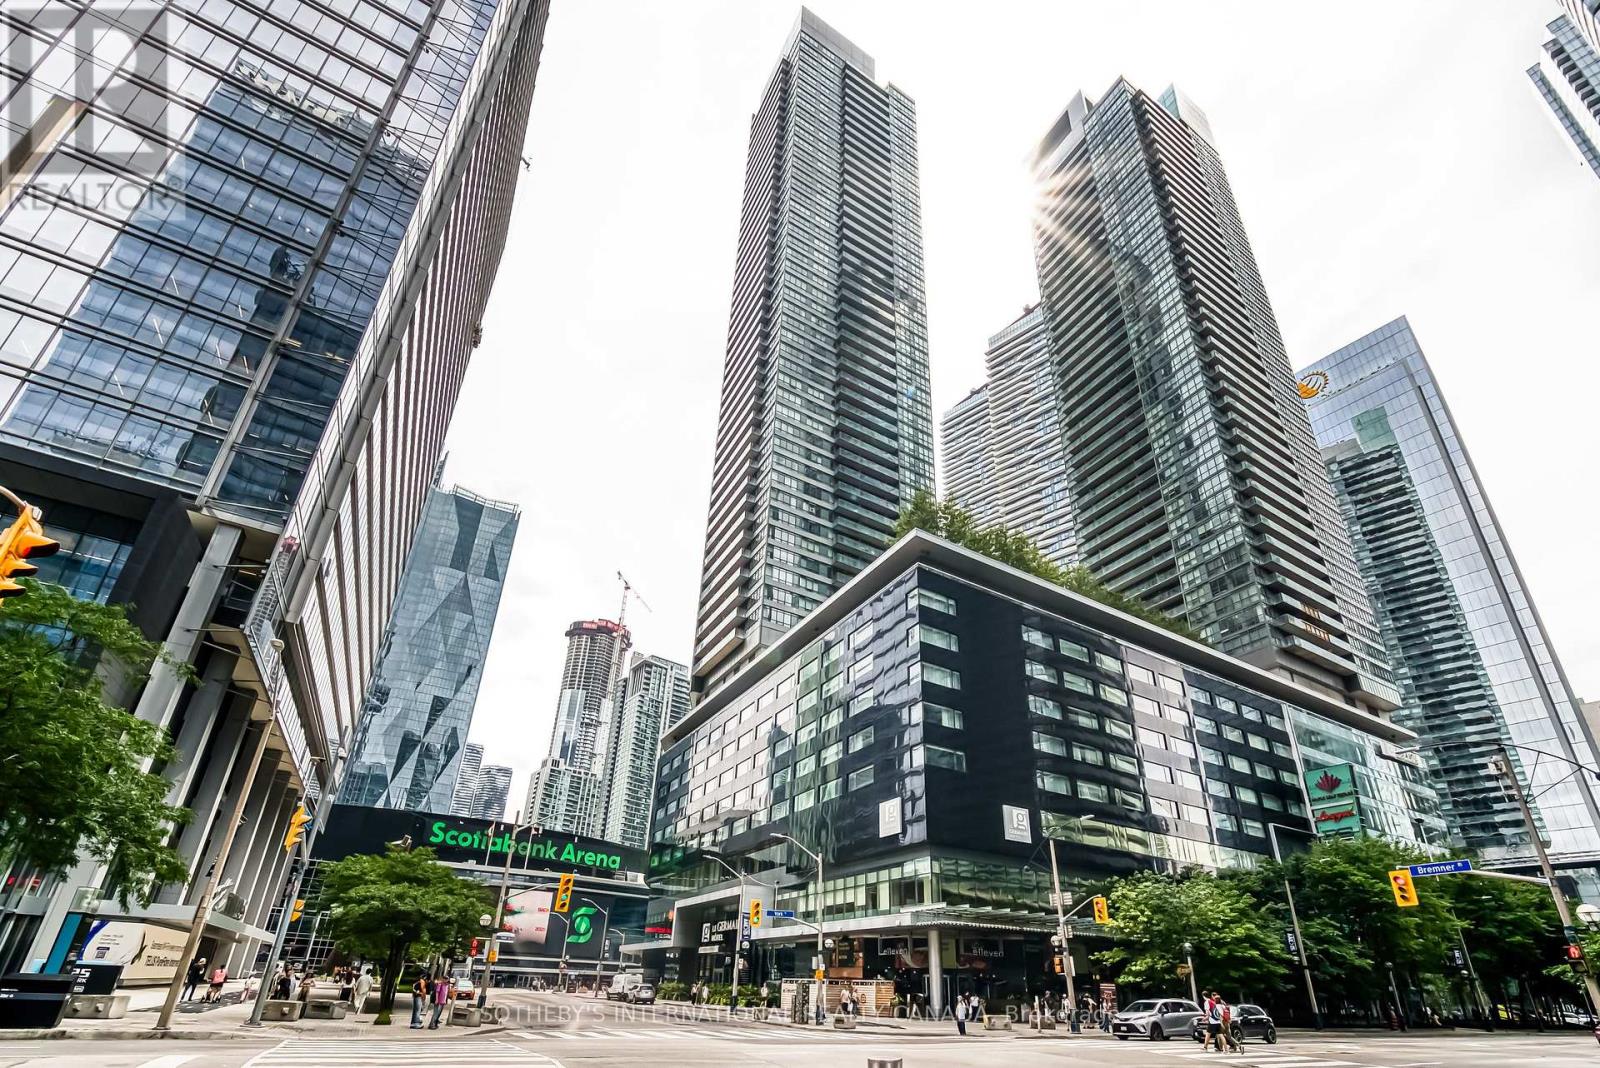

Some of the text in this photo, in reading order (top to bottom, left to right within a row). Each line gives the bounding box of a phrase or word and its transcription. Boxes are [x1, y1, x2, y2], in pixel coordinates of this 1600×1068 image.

[429, 821, 621, 869] Scotiabank Arena
[1417, 864, 1455, 874] Bremner
[717, 919, 738, 932] GERMAI
